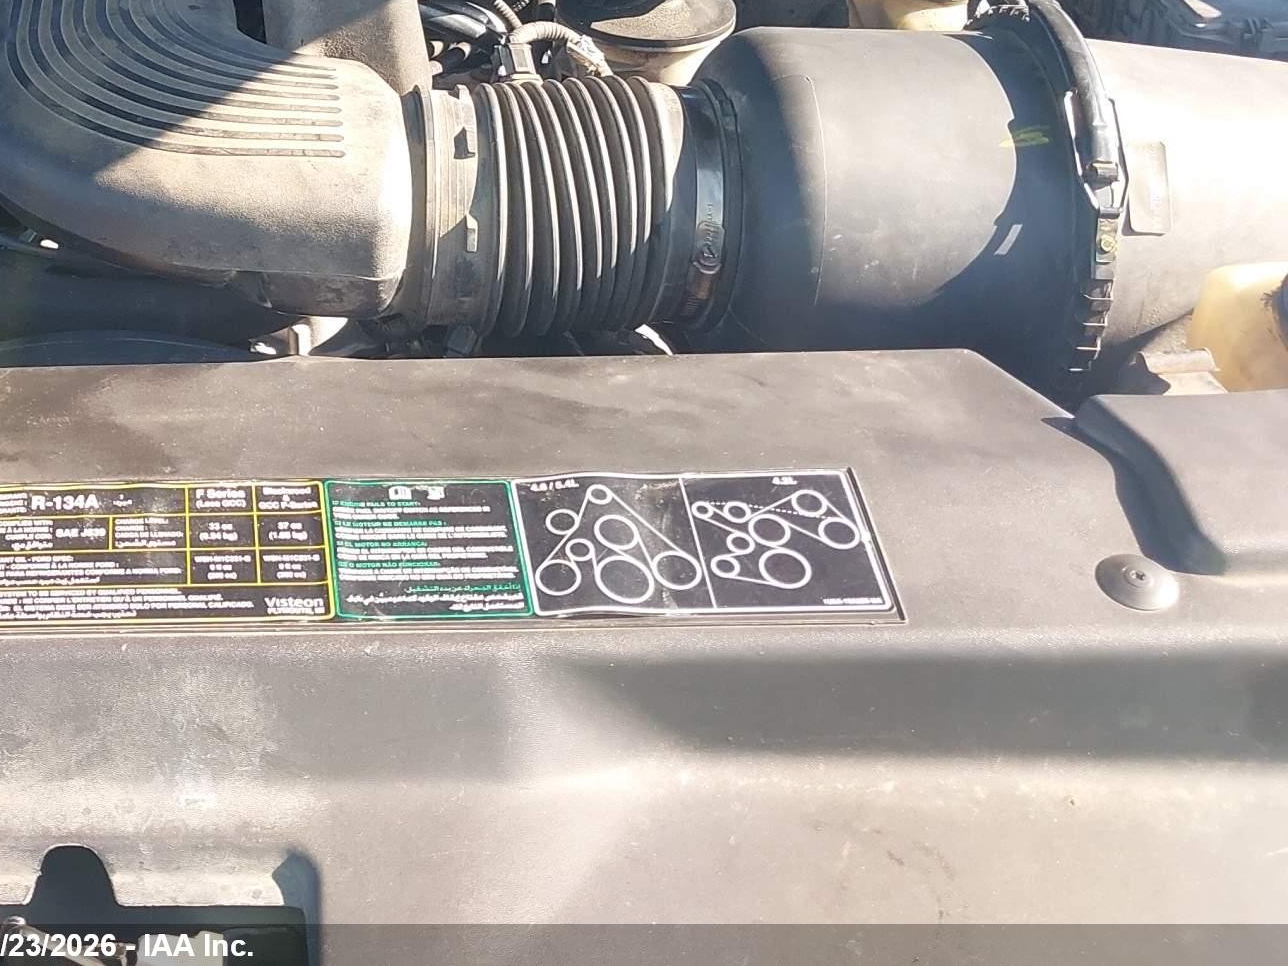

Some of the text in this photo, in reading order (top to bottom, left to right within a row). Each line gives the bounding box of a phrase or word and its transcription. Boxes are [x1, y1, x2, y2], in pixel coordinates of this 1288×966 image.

[196, 489, 204, 499] F
[31, 494, 100, 511] R-134A
[264, 597, 323, 608] Visteon
